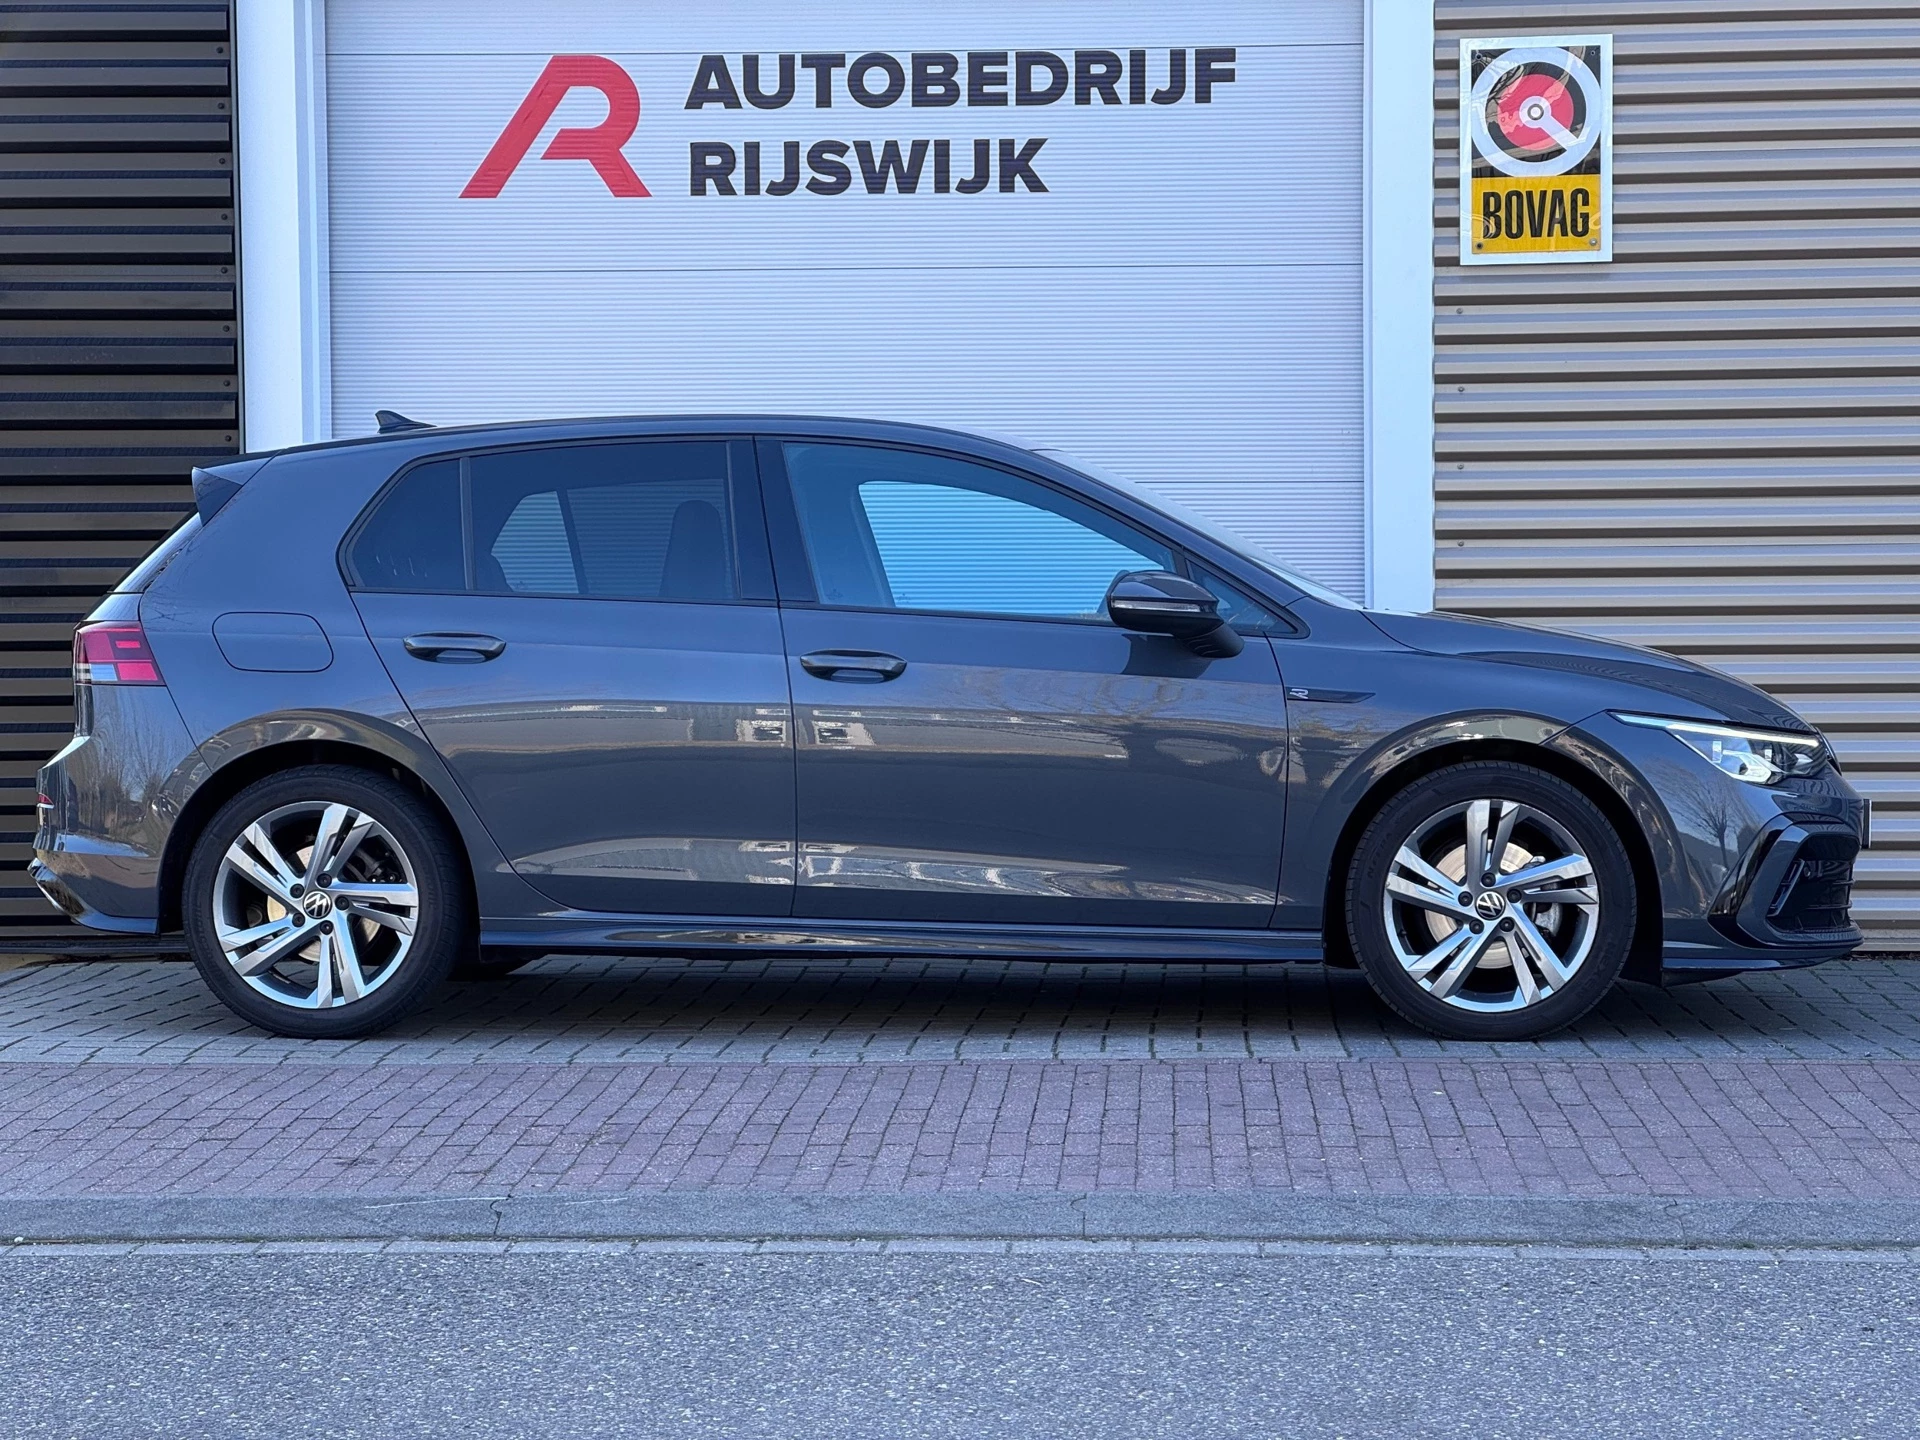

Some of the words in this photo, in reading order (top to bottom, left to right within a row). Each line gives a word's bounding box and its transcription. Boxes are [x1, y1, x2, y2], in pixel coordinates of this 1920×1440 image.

[684, 48, 1236, 109] AUTOBEDRIJF
[690, 138, 1049, 196] RIJSWIJK
[1482, 188, 1590, 240] BOVAG
